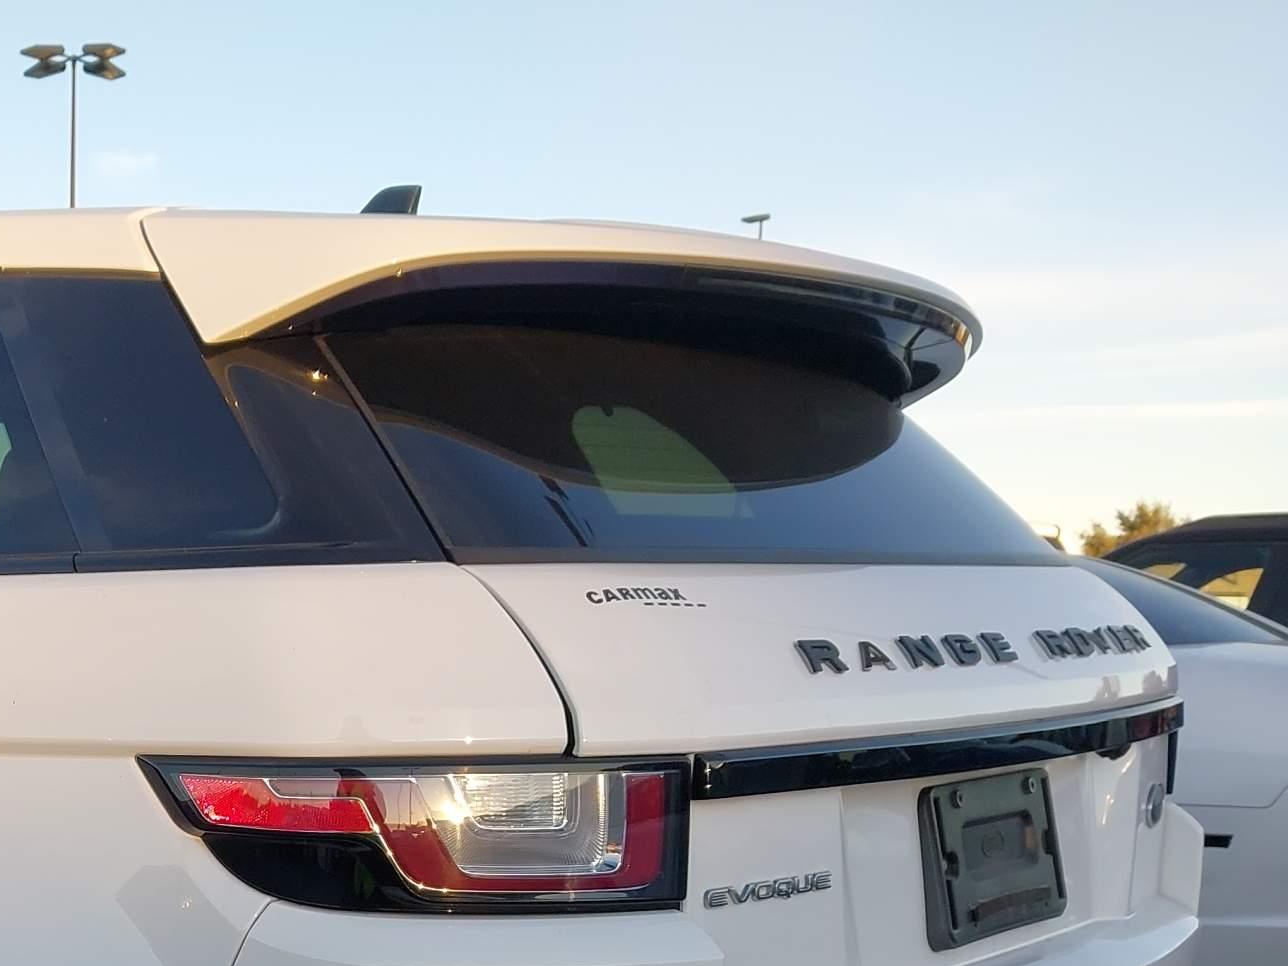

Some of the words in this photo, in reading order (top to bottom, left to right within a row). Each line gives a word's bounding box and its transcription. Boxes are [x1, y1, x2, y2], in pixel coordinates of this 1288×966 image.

[795, 632, 1018, 673] RANGE
[1031, 624, 1152, 660] ROVER
[703, 870, 833, 910] EVOQUE
